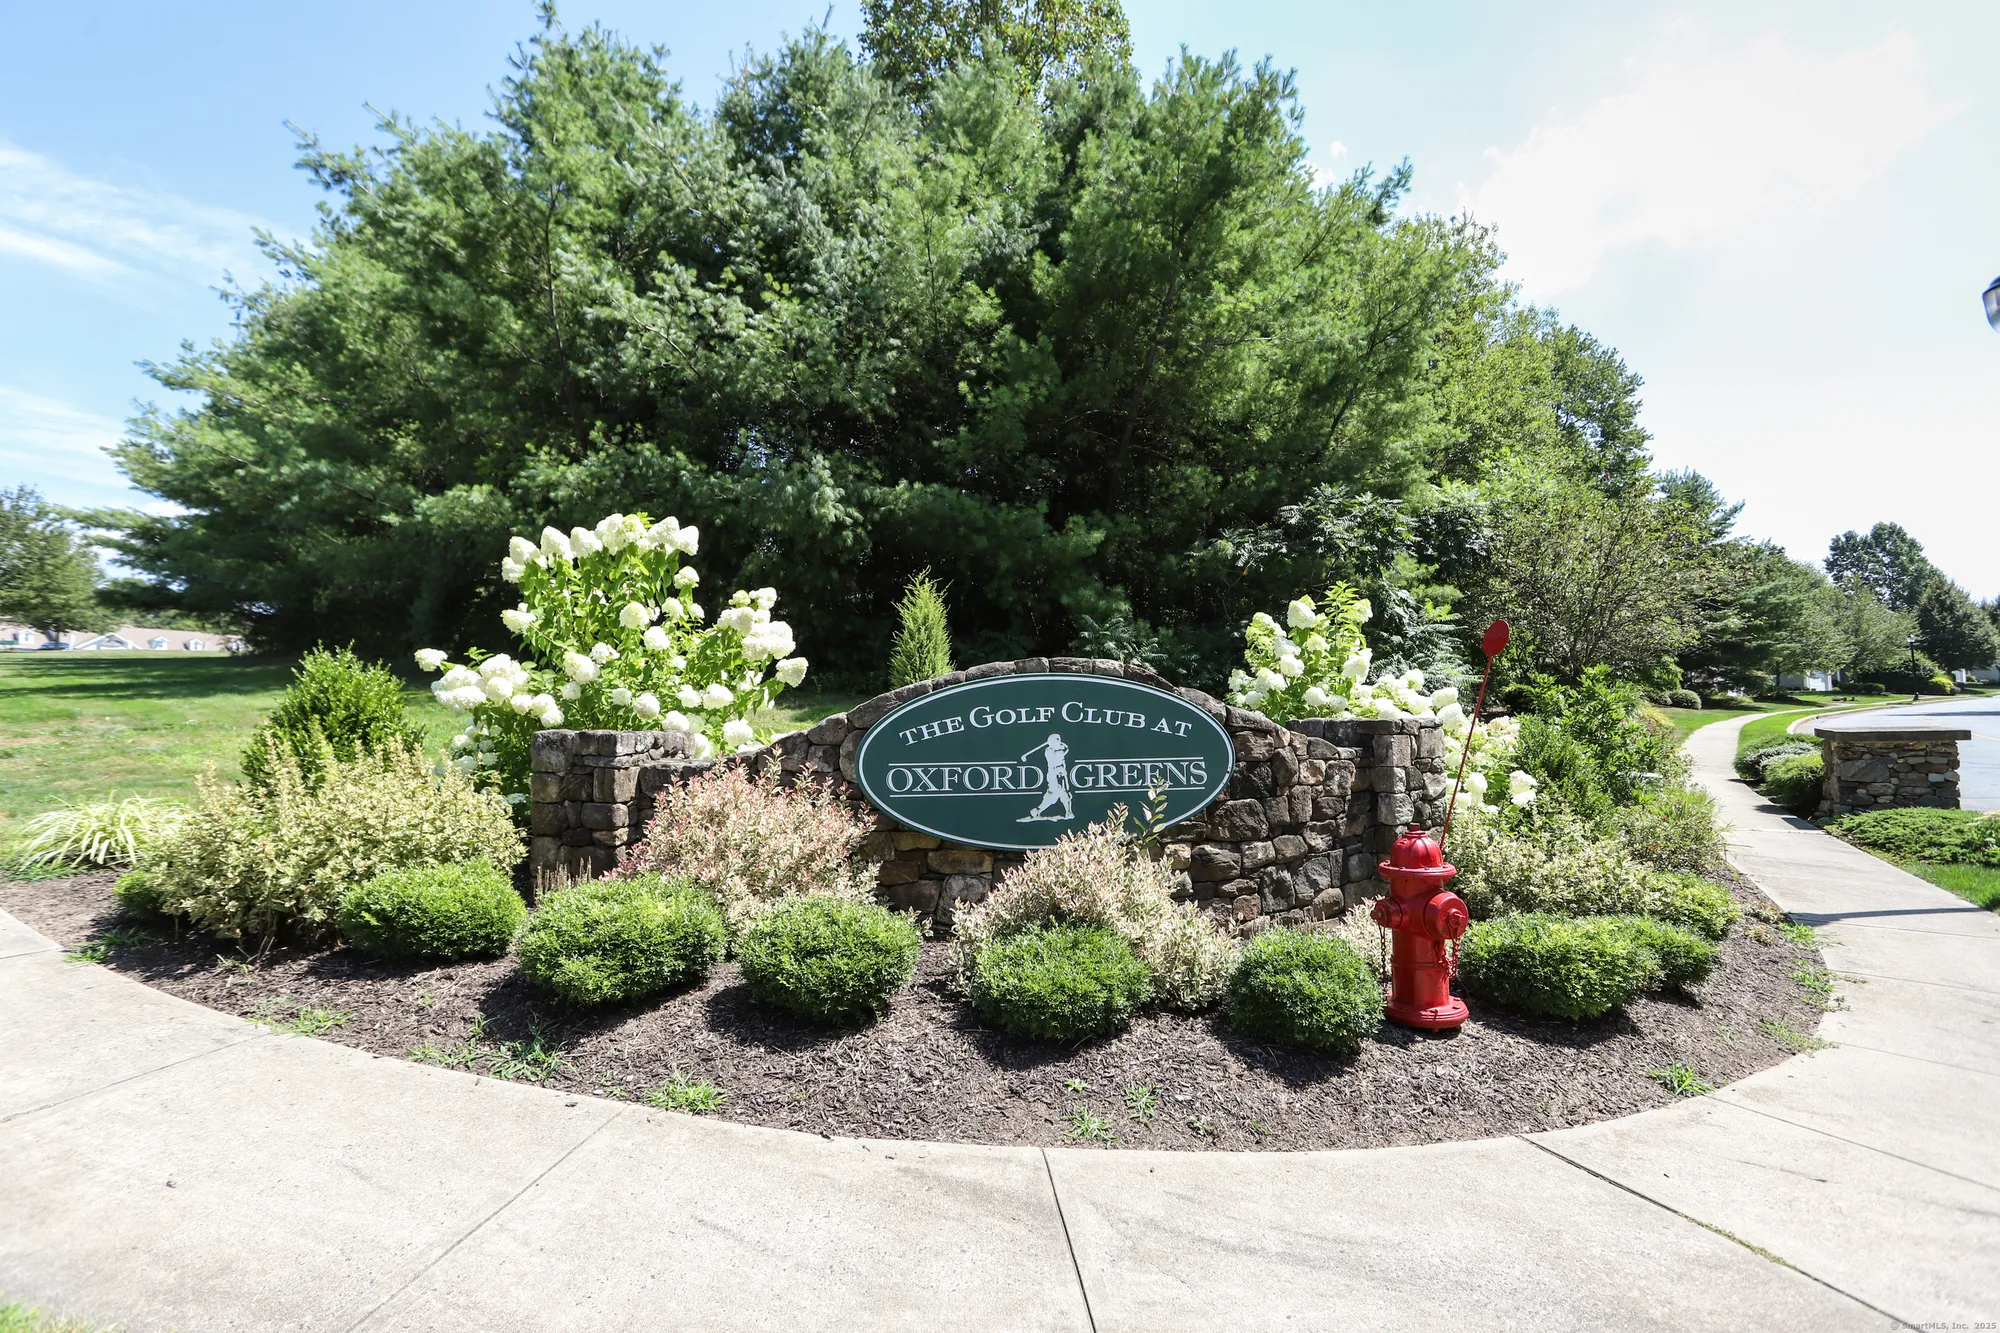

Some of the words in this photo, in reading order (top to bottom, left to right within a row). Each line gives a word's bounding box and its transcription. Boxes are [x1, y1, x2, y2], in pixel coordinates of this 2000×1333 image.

[899, 716, 965, 746] THE
[969, 705, 1055, 728] GOLF
[1061, 701, 1147, 729] CLUB
[1151, 717, 1192, 738] AT
[885, 765, 1043, 792] OXFORD
[1069, 761, 1208, 788] GREENS
